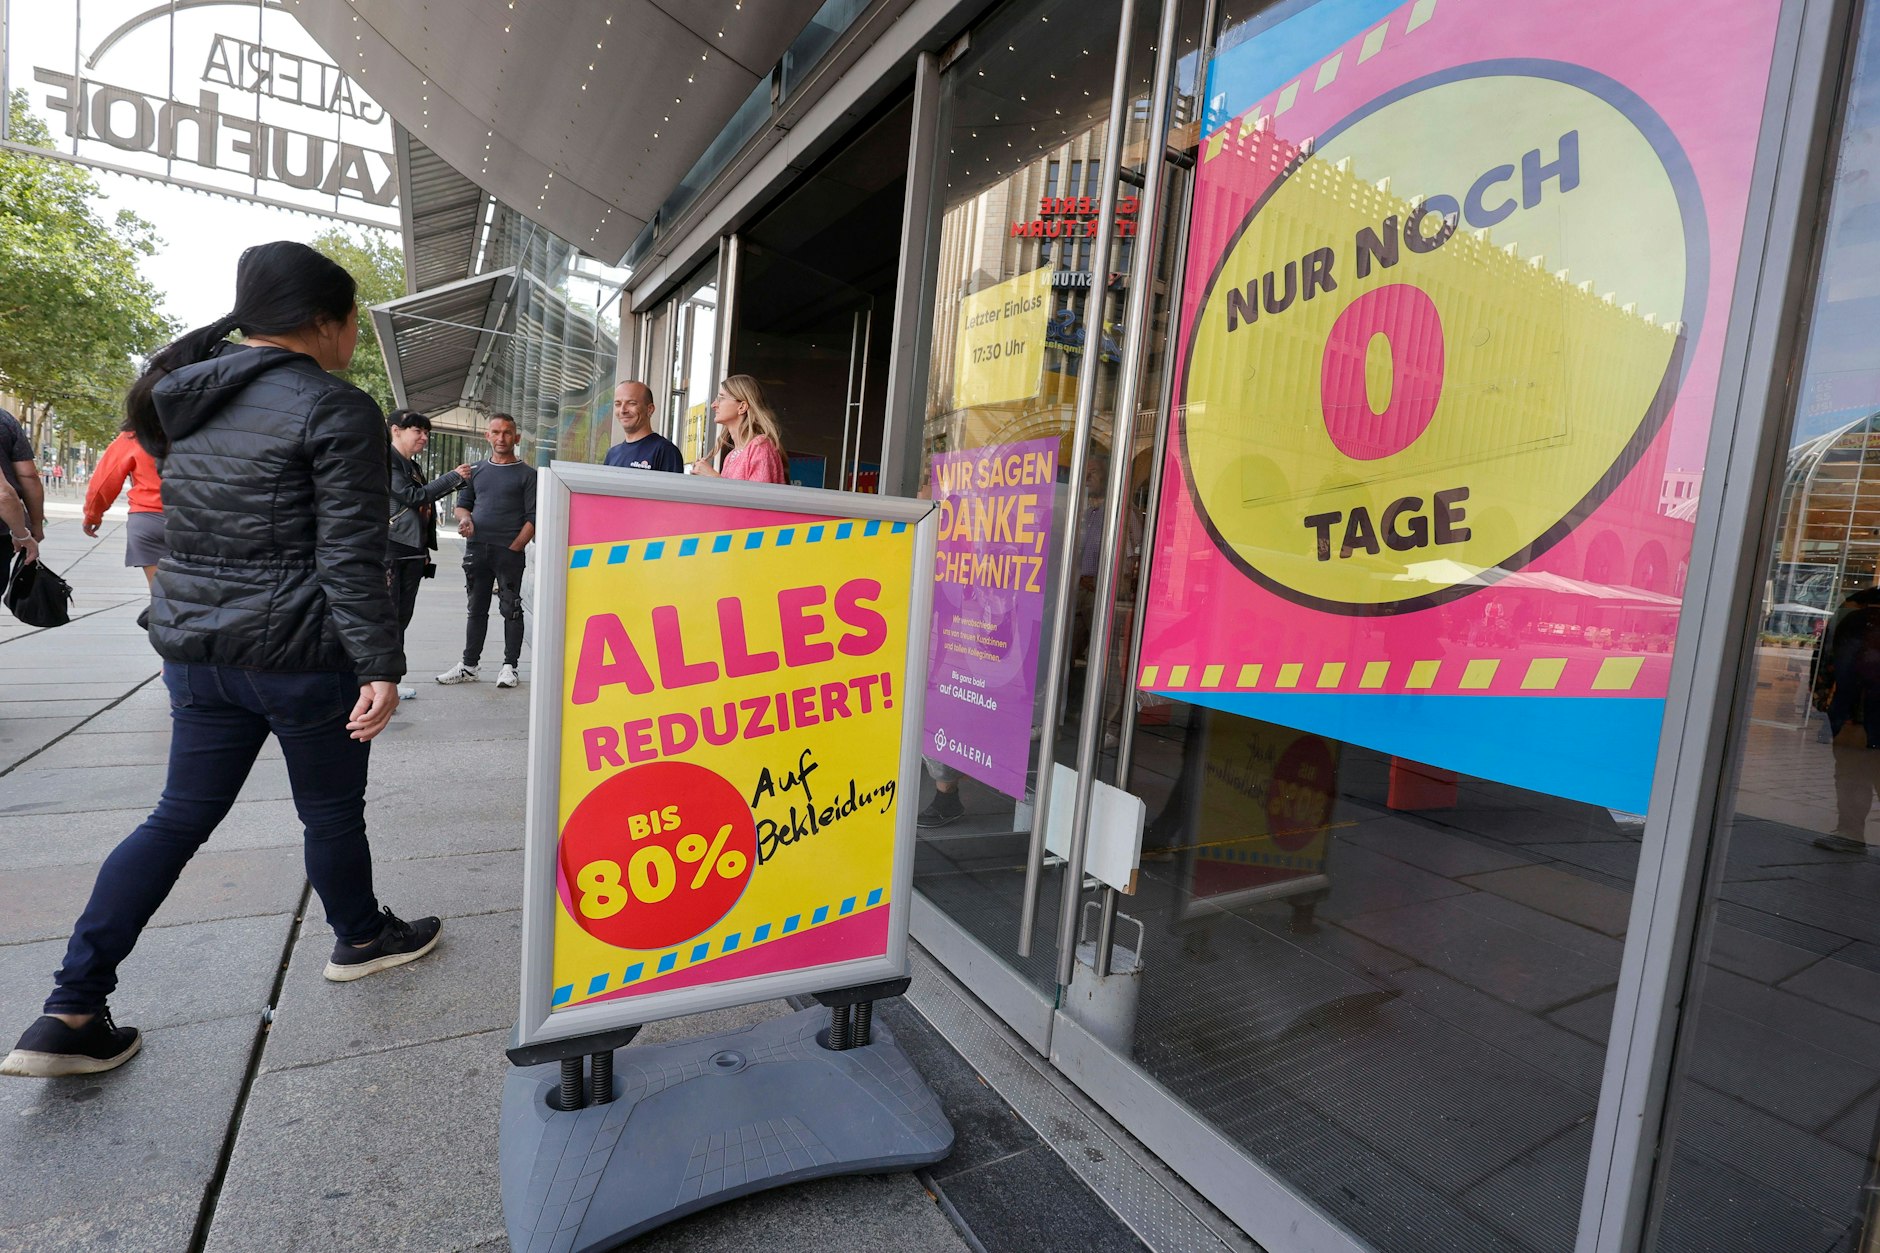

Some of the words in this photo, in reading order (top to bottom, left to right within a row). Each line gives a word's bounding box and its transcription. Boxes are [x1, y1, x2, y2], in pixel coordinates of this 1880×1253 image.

[1226, 246, 1337, 333] NUR
[1355, 129, 1580, 279] NOCH
[964, 307, 1002, 332] Letzter
[1003, 293, 1042, 320] Einlass
[972, 347, 1001, 364] 17:30
[1005, 340, 1026, 359] Uhr
[1321, 283, 1445, 461] 0
[936, 461, 973, 492] WIR
[977, 450, 1053, 489] SAGEN
[938, 493, 1046, 554] DANKE,
[1304, 486, 1472, 562] TAGE
[934, 550, 1043, 593] CHEMNITZ
[571, 578, 888, 705] ALLES
[952, 614, 962, 625] Wir
[939, 683, 952, 696] auf
[952, 685, 997, 710] GALERIA.de
[951, 670, 959, 681] Bis
[959, 674, 973, 686] ganz
[972, 676, 986, 689] bald
[582, 672, 893, 772] REDUZIERT!
[751, 748, 818, 808] Auf
[949, 739, 992, 768] GALERIA
[627, 805, 682, 841] BIS
[755, 778, 896, 865] Bekleidung
[576, 823, 747, 920] 80%
